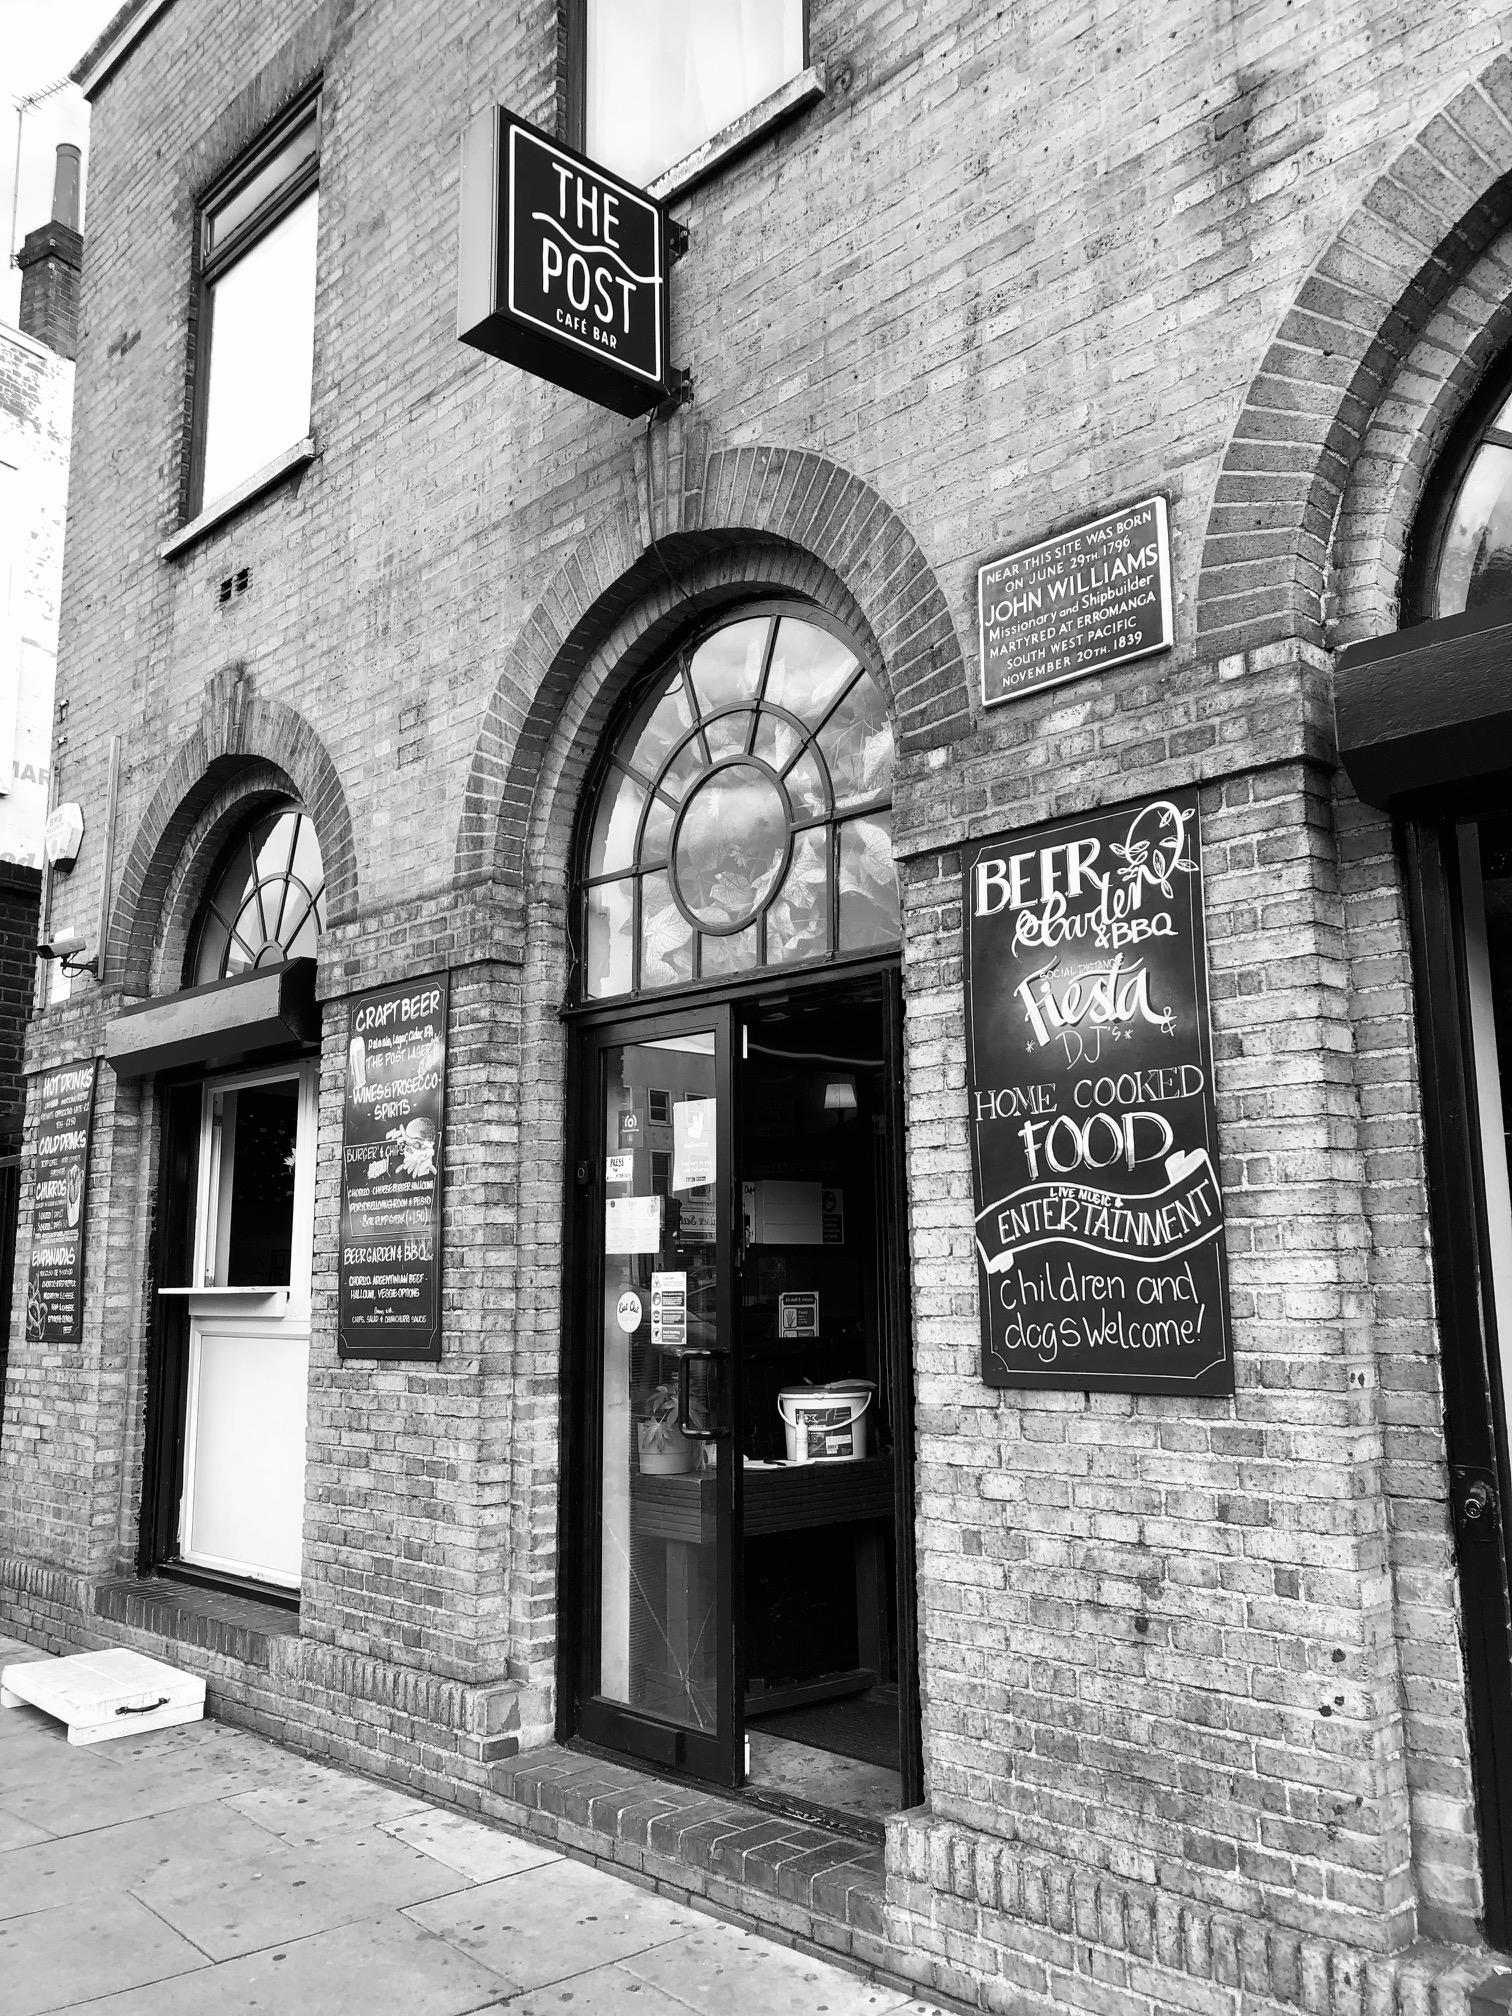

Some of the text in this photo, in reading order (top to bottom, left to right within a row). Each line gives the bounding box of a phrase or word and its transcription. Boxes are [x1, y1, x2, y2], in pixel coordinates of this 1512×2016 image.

[552, 162, 620, 248] THE
[542, 237, 637, 334] POST
[556, 308, 618, 350] CAFÉ BAR
[986, 510, 1152, 586] NEAR THIS SITE WAS BORN
[1005, 577, 1024, 592] ON
[1028, 562, 1064, 586] JUNE
[1102, 535, 1131, 556] 1796
[984, 543, 1158, 626] JOHN WILLIAMS
[989, 573, 1154, 642] Missionary and Shipbuilder
[990, 591, 1156, 658] MARTYRED AT ERROMANGA
[1006, 616, 1137, 670] SOUTH WEST PACIFIC
[1002, 657, 1072, 688] NOVEMBER
[1113, 631, 1143, 650] 1839
[974, 837, 1111, 917] BEER
[1013, 952, 1177, 1046] Fiesta
[1040, 966, 1078, 981] SOCIAL
[355, 990, 440, 1032] CRAFT BEER
[43, 1073, 62, 1098] HOT
[60, 1067, 94, 1094] DRINKS
[366, 1052, 384, 1070] THE
[385, 1048, 406, 1066] POST
[392, 1072, 438, 1098] PROSECCO
[374, 1098, 410, 1120] SPIRITS
[974, 1064, 1204, 1121] HOME COOKED
[38, 1130, 86, 1156] COLD DRINKS
[1018, 1111, 1174, 1181] FOOD
[36, 1178, 66, 1200] CHURROS
[998, 1178, 1212, 1246] ENTERTAINMENT
[1050, 1186, 1074, 1201] LIVE
[1078, 1188, 1112, 1208] MUSIC
[32, 1246, 76, 1267] EMPANADAS
[344, 1248, 366, 1266] BEER
[366, 1244, 396, 1263] GARDEN
[1136, 1260, 1199, 1304] and
[1005, 1312, 1082, 1362] dogs
